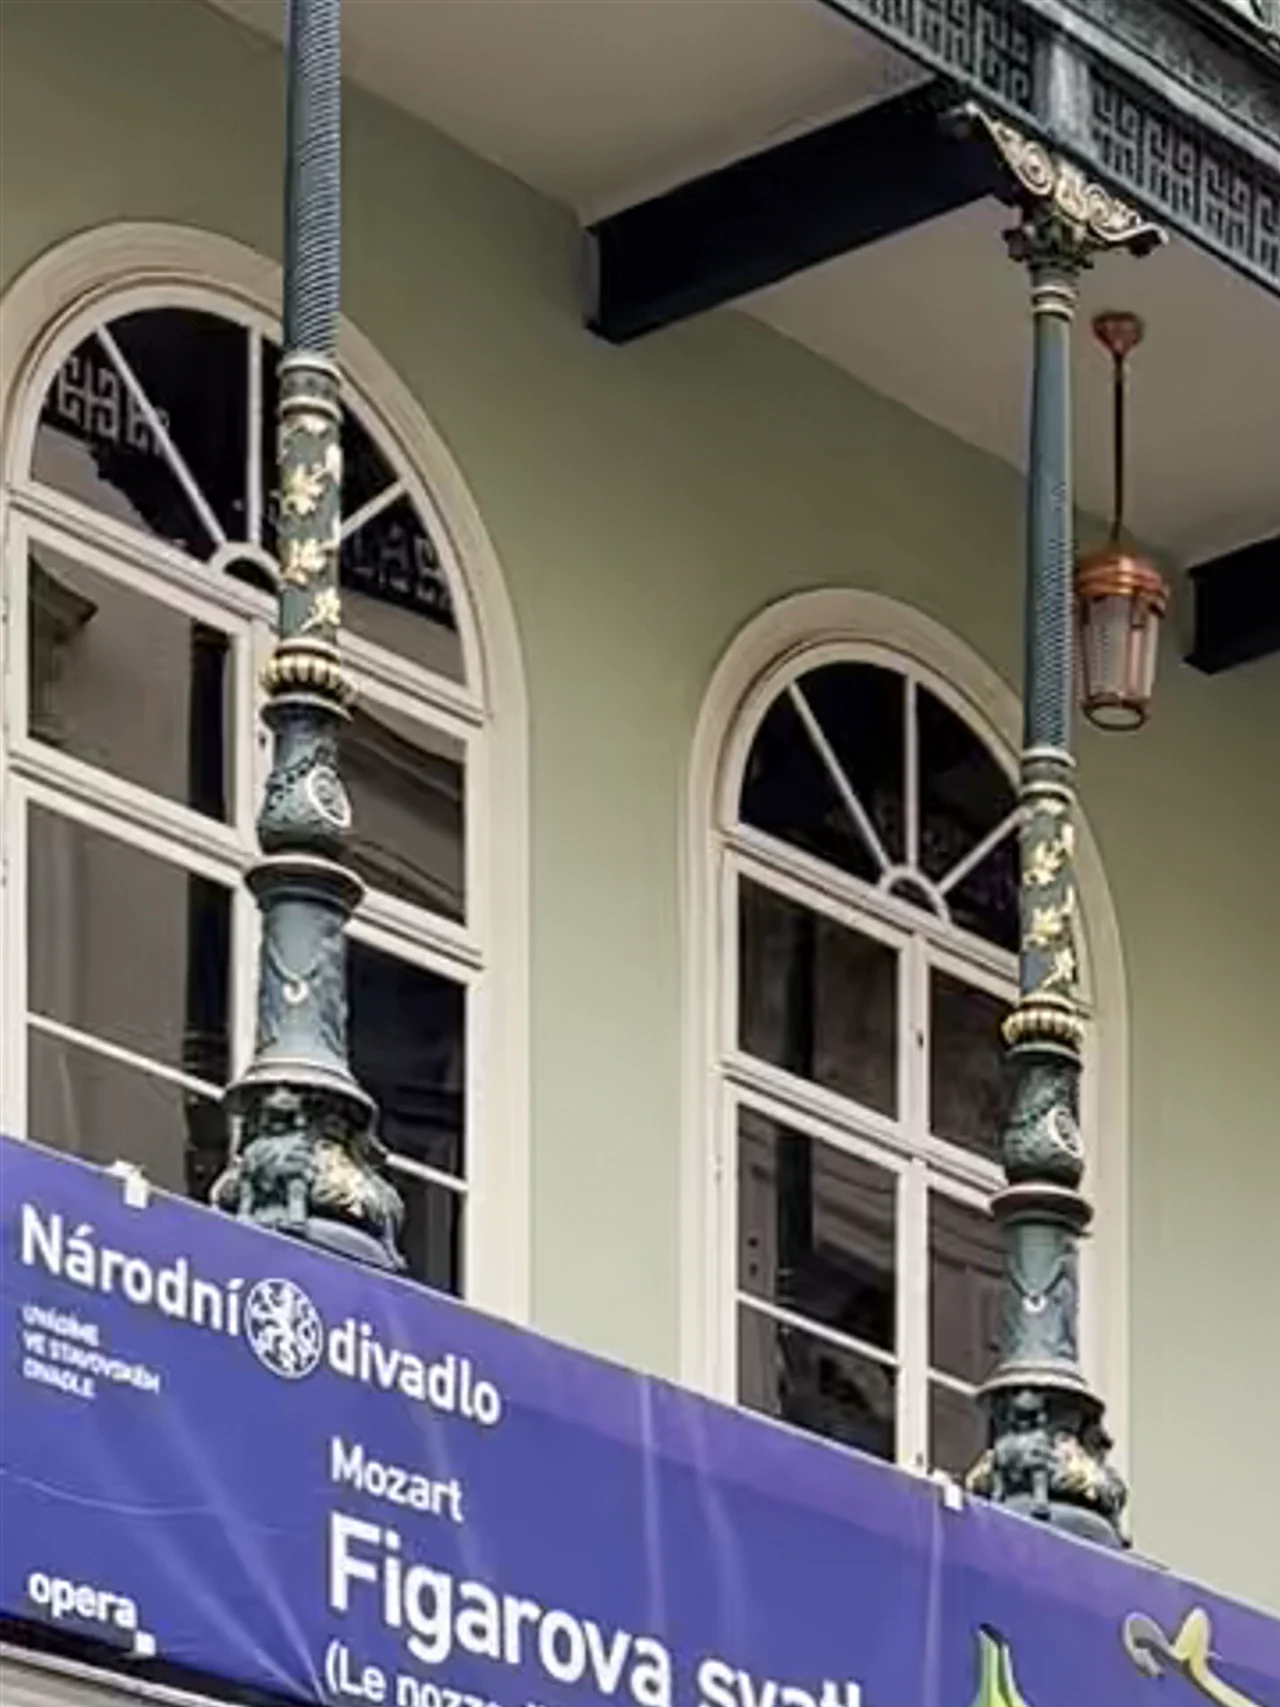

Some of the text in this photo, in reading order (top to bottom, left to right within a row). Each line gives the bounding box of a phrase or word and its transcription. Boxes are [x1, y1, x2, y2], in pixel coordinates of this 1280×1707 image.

[20, 1202, 500, 1425] Národní divadlo
[330, 1436, 465, 1522] Mozart
[28, 1572, 138, 1629] opera
[324, 1640, 386, 1702] (Le
